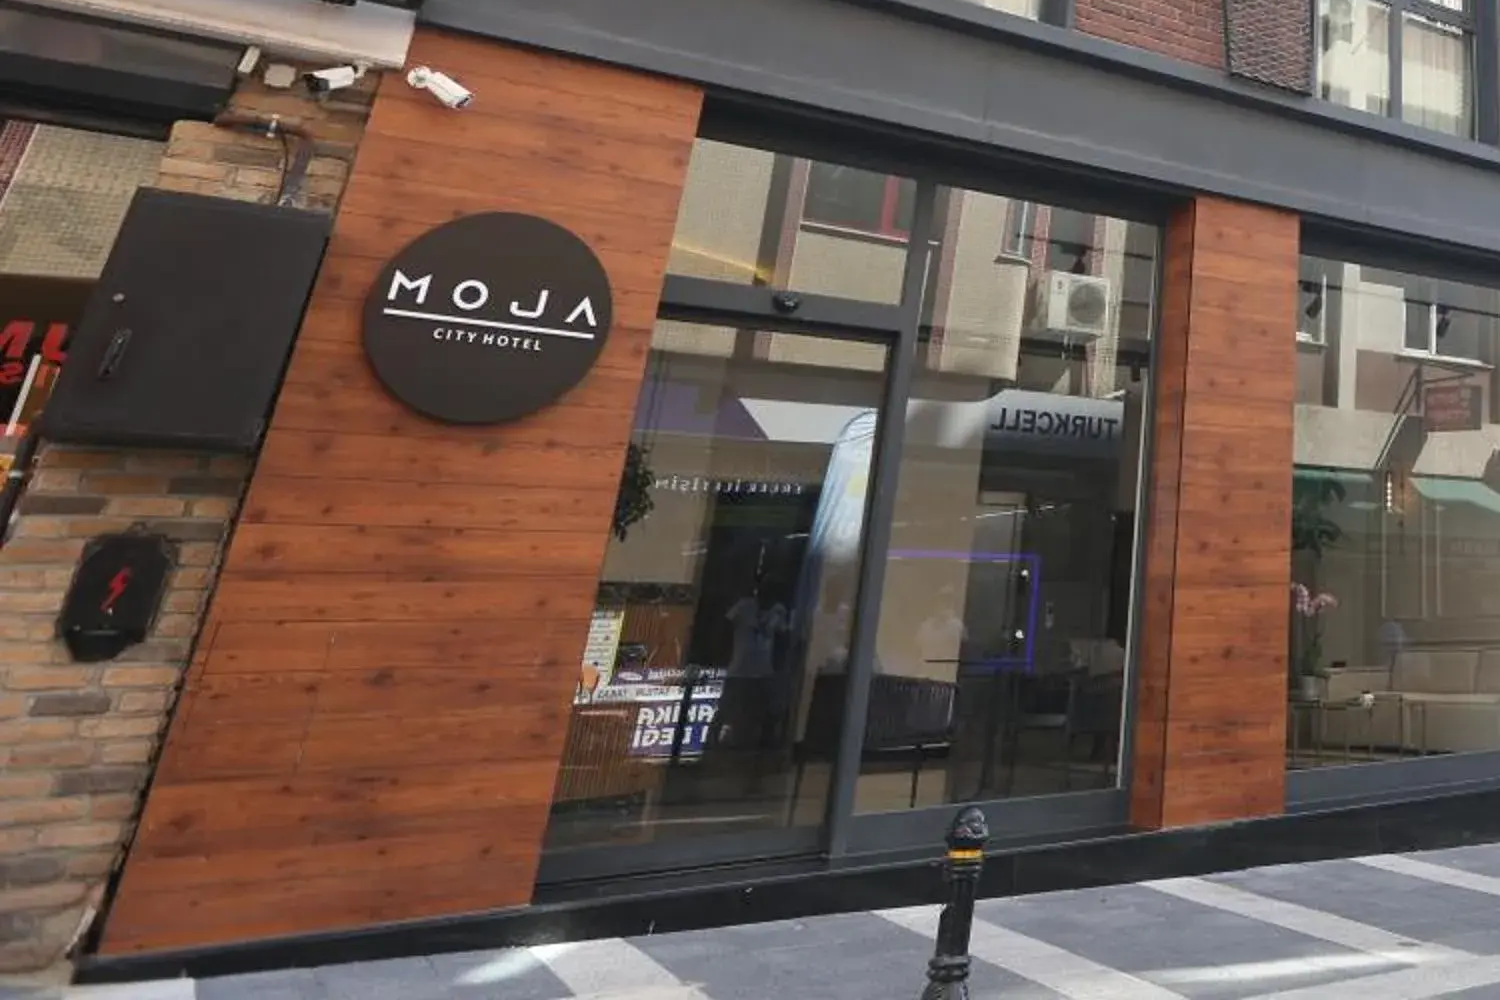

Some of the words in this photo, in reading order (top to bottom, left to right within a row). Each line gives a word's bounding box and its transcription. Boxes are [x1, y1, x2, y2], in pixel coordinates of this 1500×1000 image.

[387, 269, 597, 326] MOJA
[432, 327, 477, 344] CITY
[482, 334, 542, 351] HOTEL
